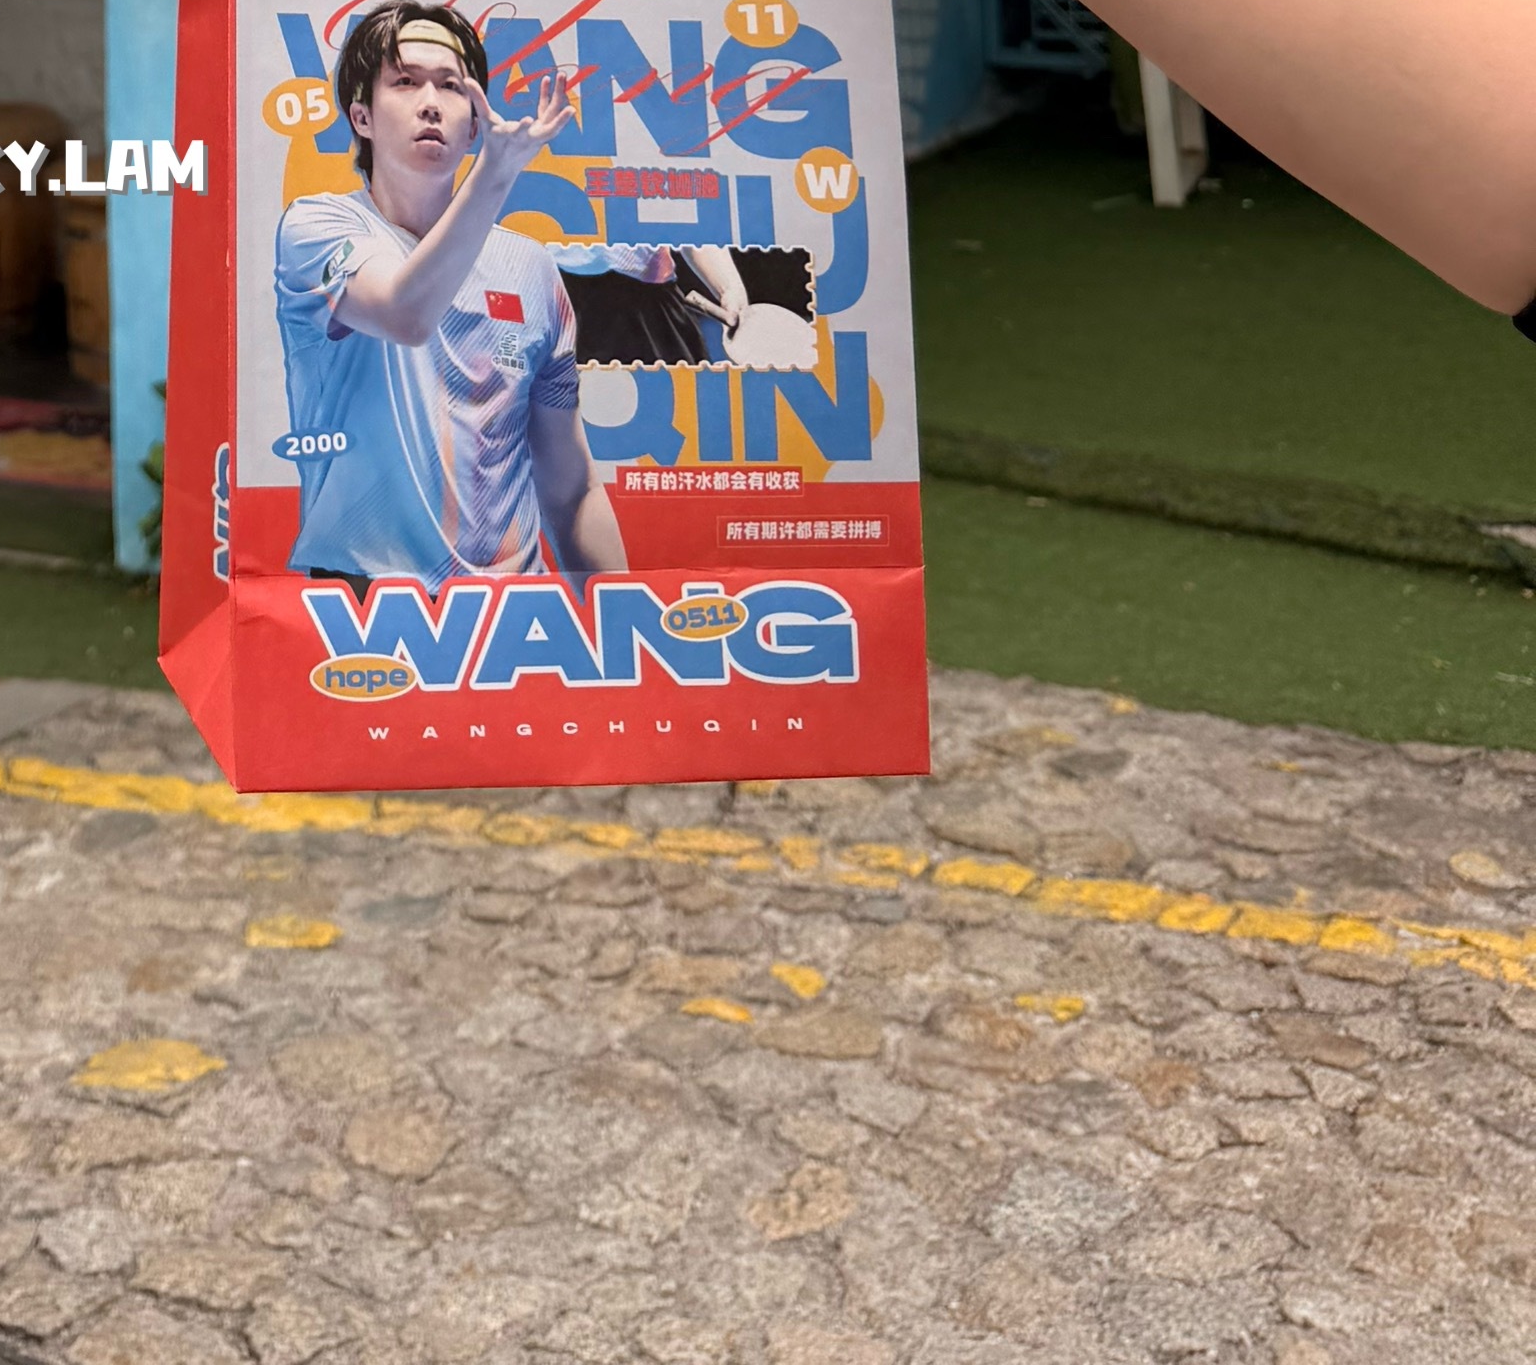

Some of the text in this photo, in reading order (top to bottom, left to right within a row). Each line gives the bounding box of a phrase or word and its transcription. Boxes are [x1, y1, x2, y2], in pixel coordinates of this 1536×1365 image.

[737, 3, 785, 36] 11
[274, 90, 330, 122] 05
[802, 163, 855, 199] W
[285, 433, 348, 456] 2000
[624, 471, 800, 492] 所有的汗水都会有收获
[725, 520, 882, 540] 所有期许都需要拼搏
[667, 602, 742, 631] 0511
[300, 579, 861, 693] WANG
[324, 665, 410, 695] hope
[368, 716, 805, 740] WANGCHUQIN
